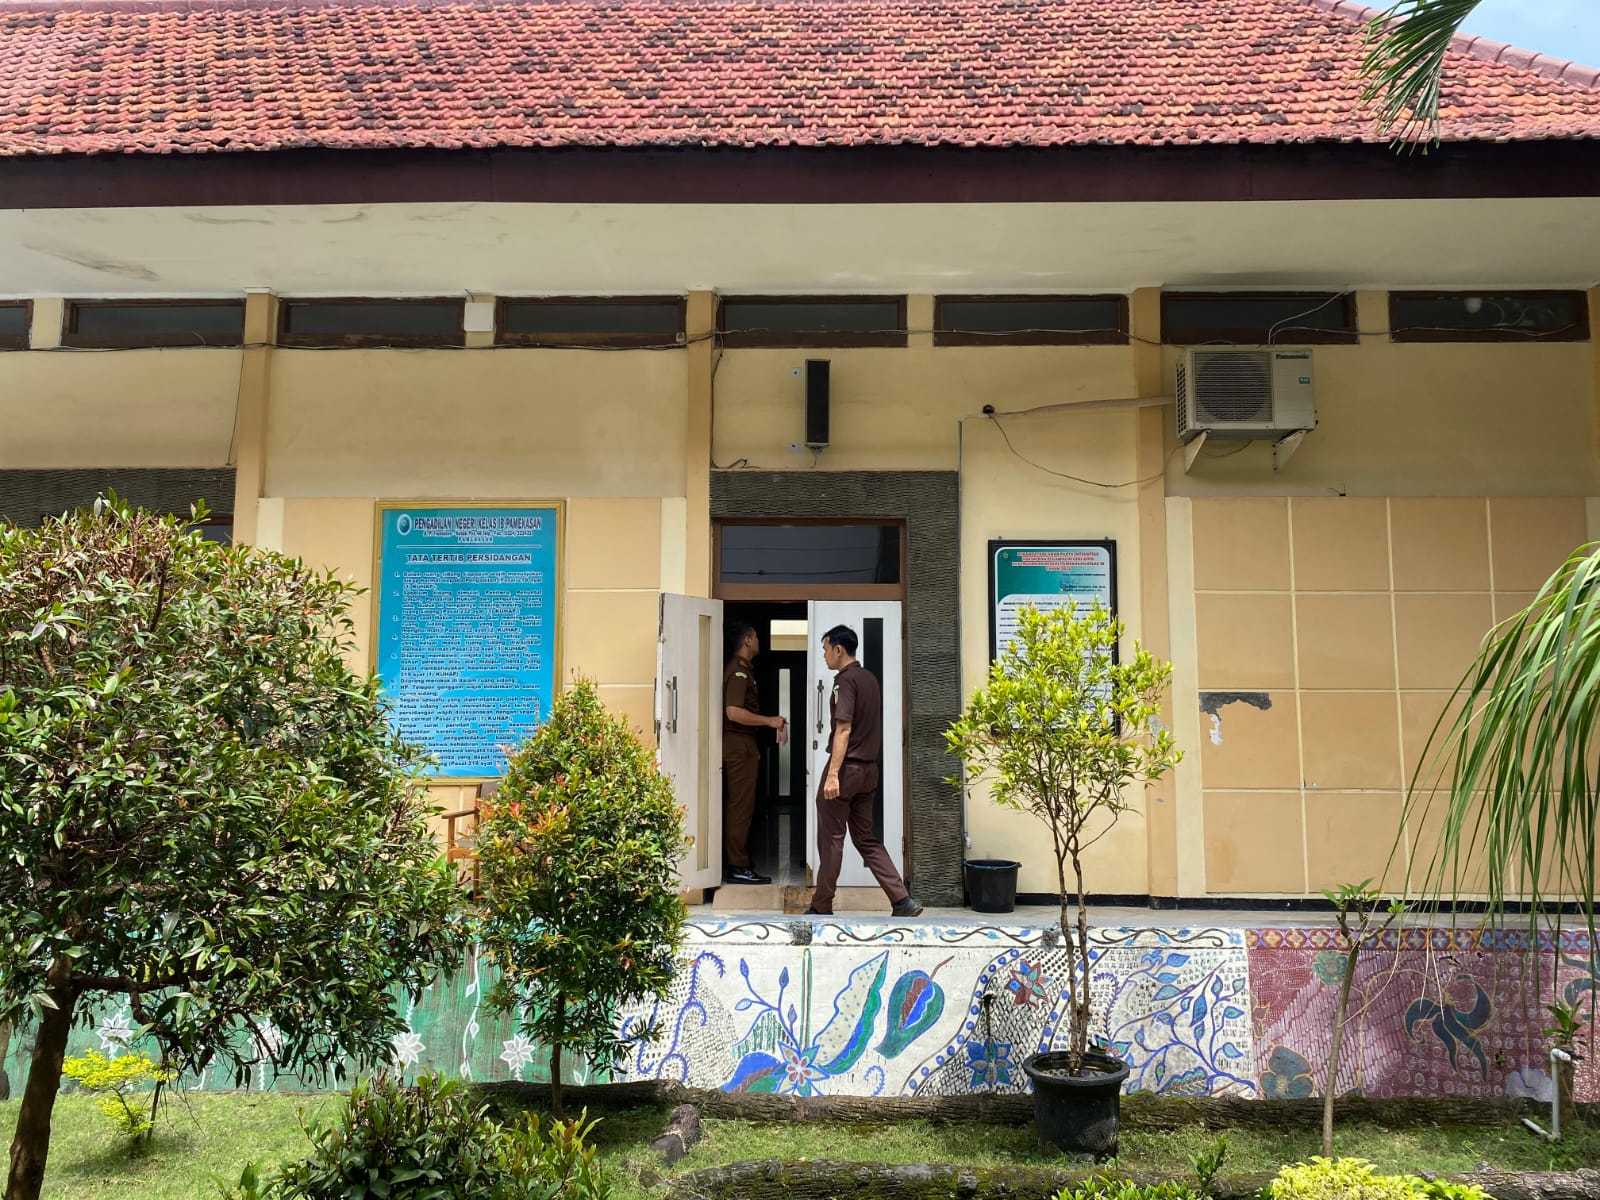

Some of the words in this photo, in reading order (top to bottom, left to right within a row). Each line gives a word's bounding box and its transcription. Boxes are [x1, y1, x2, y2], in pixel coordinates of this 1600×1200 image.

[414, 517, 452, 530] PENGADILAN
[455, 517, 476, 530] NEGERI
[478, 517, 497, 530] KELAS
[505, 517, 541, 530] PAMEKASAN
